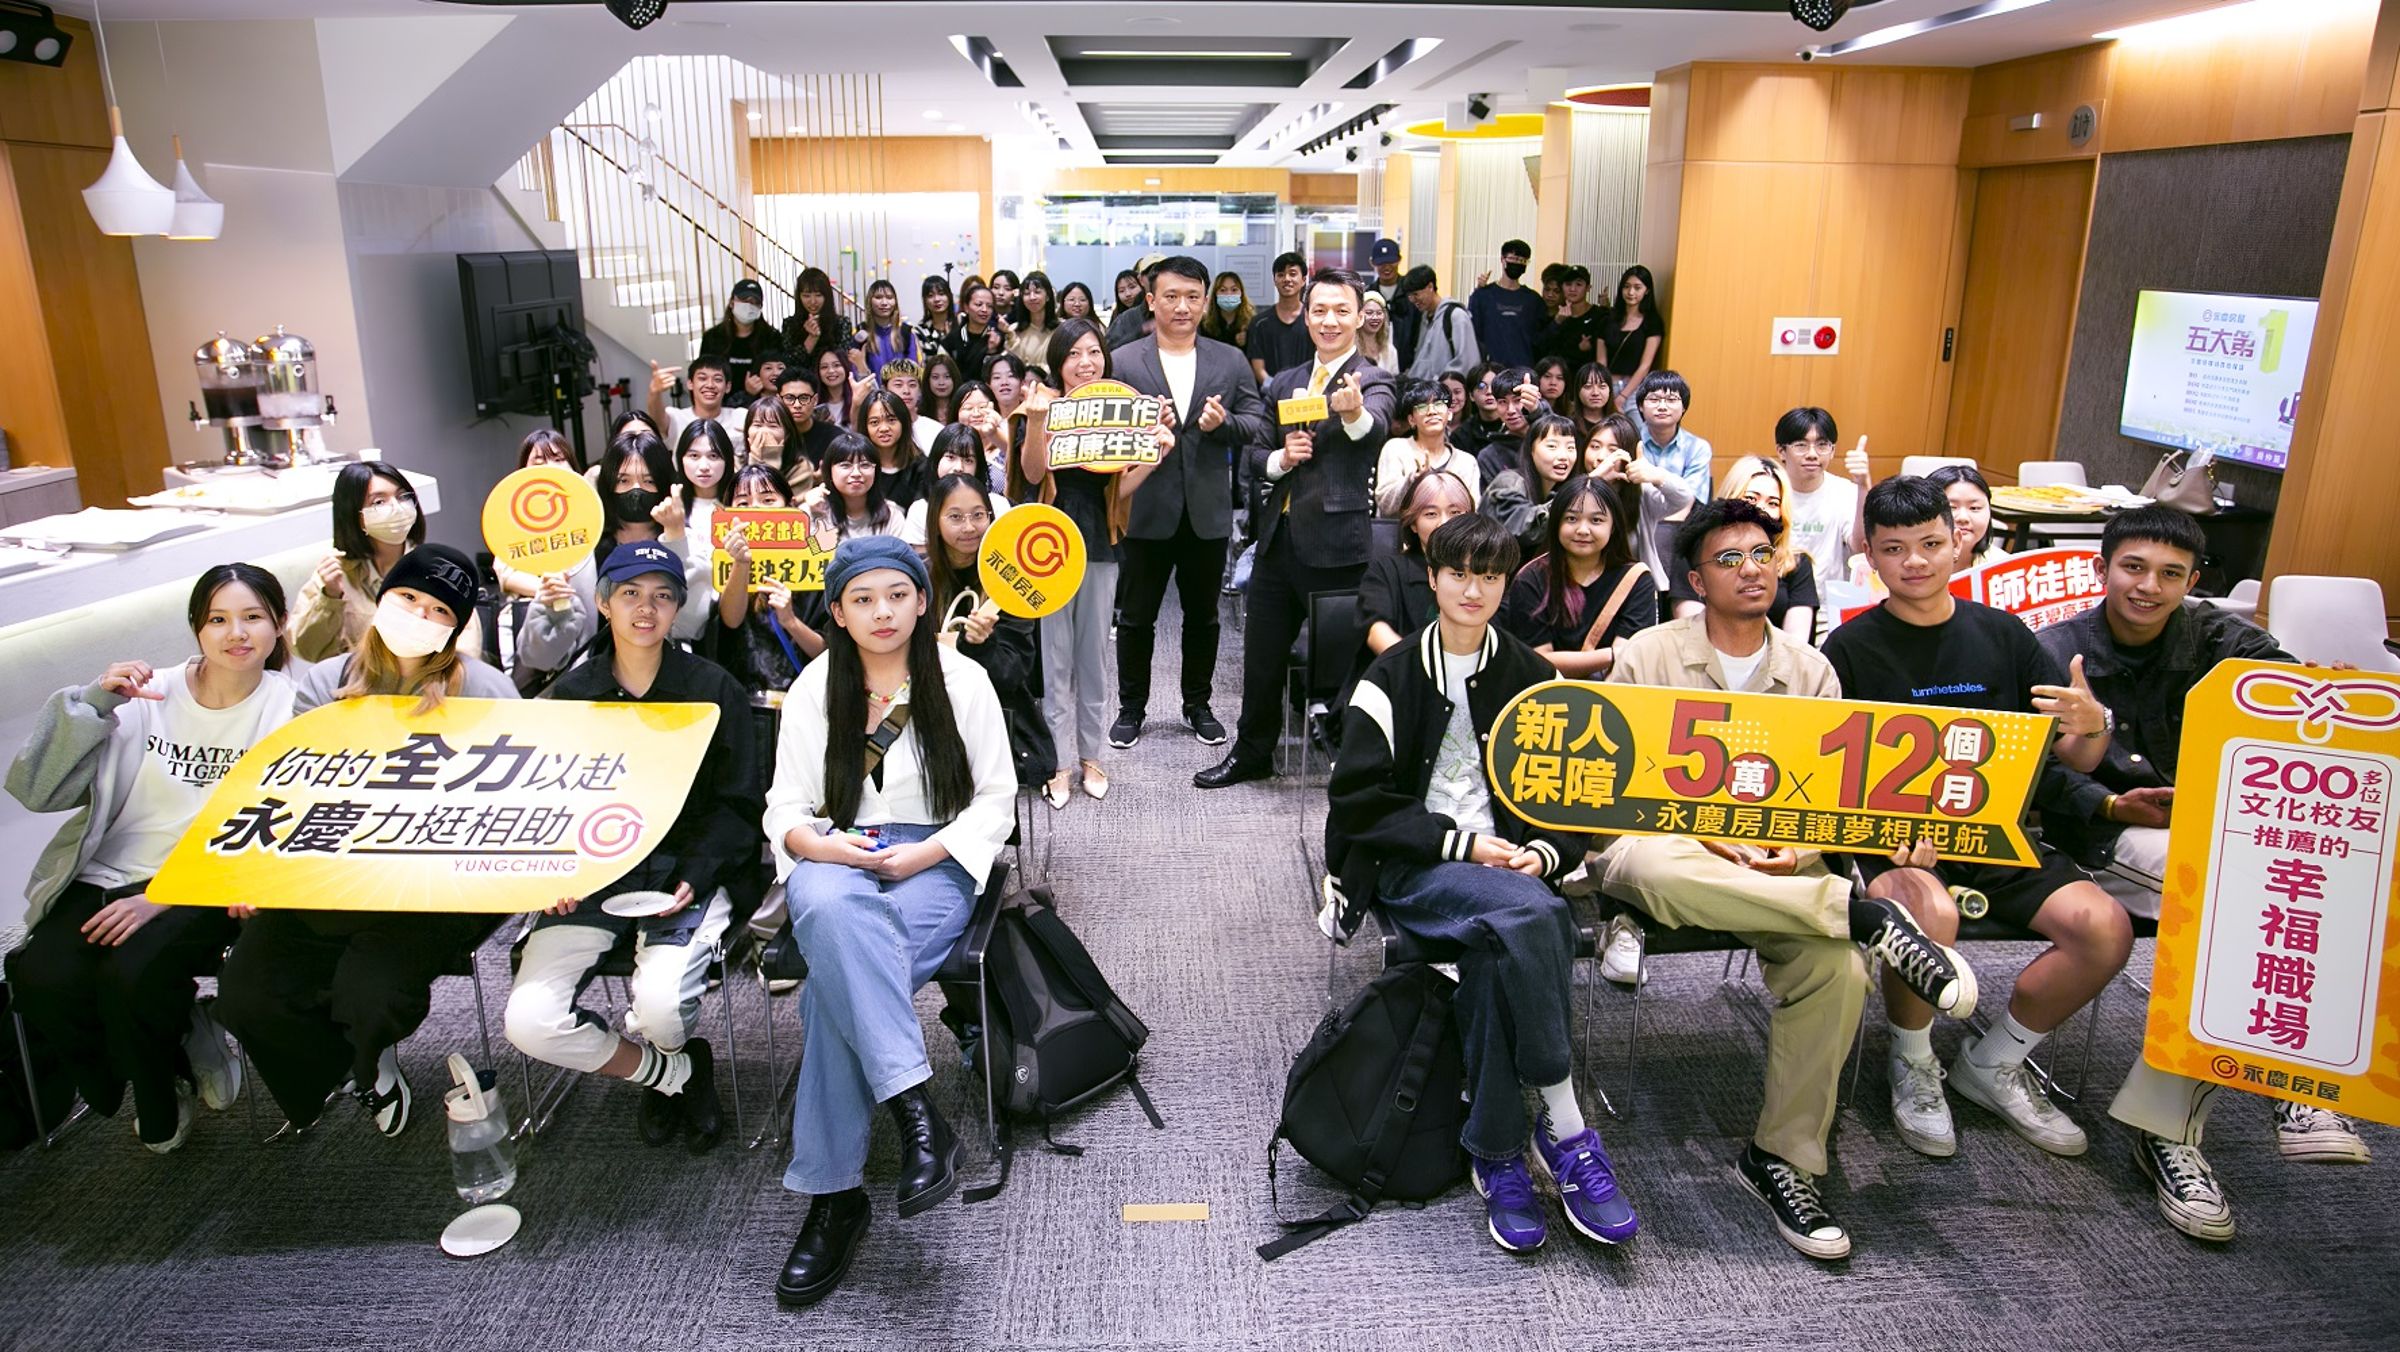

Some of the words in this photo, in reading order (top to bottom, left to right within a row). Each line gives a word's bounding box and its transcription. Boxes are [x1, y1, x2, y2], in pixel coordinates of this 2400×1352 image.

[1047, 399, 1160, 431] 聰明工作
[1050, 432, 1159, 465] 健康生活
[508, 528, 590, 560] 永慶房屋
[985, 549, 1046, 611] 永慶房屋
[1988, 556, 2103, 611] 師徒制
[1513, 698, 1620, 755] 新人
[261, 733, 626, 793] 你的全力以赴
[1510, 752, 1617, 809] 保障
[211, 796, 575, 853] 永慶力挺相助
[1655, 801, 1990, 855] 永慶房屋讓夢想起航
[2238, 792, 2381, 833] 文化校友
[454, 859, 577, 872] YUNGCHING
[2253, 824, 2350, 859] 推薦的
[2247, 858, 2327, 1050] 幸福職場
[2243, 1063, 2340, 1102] 永慶房屋
